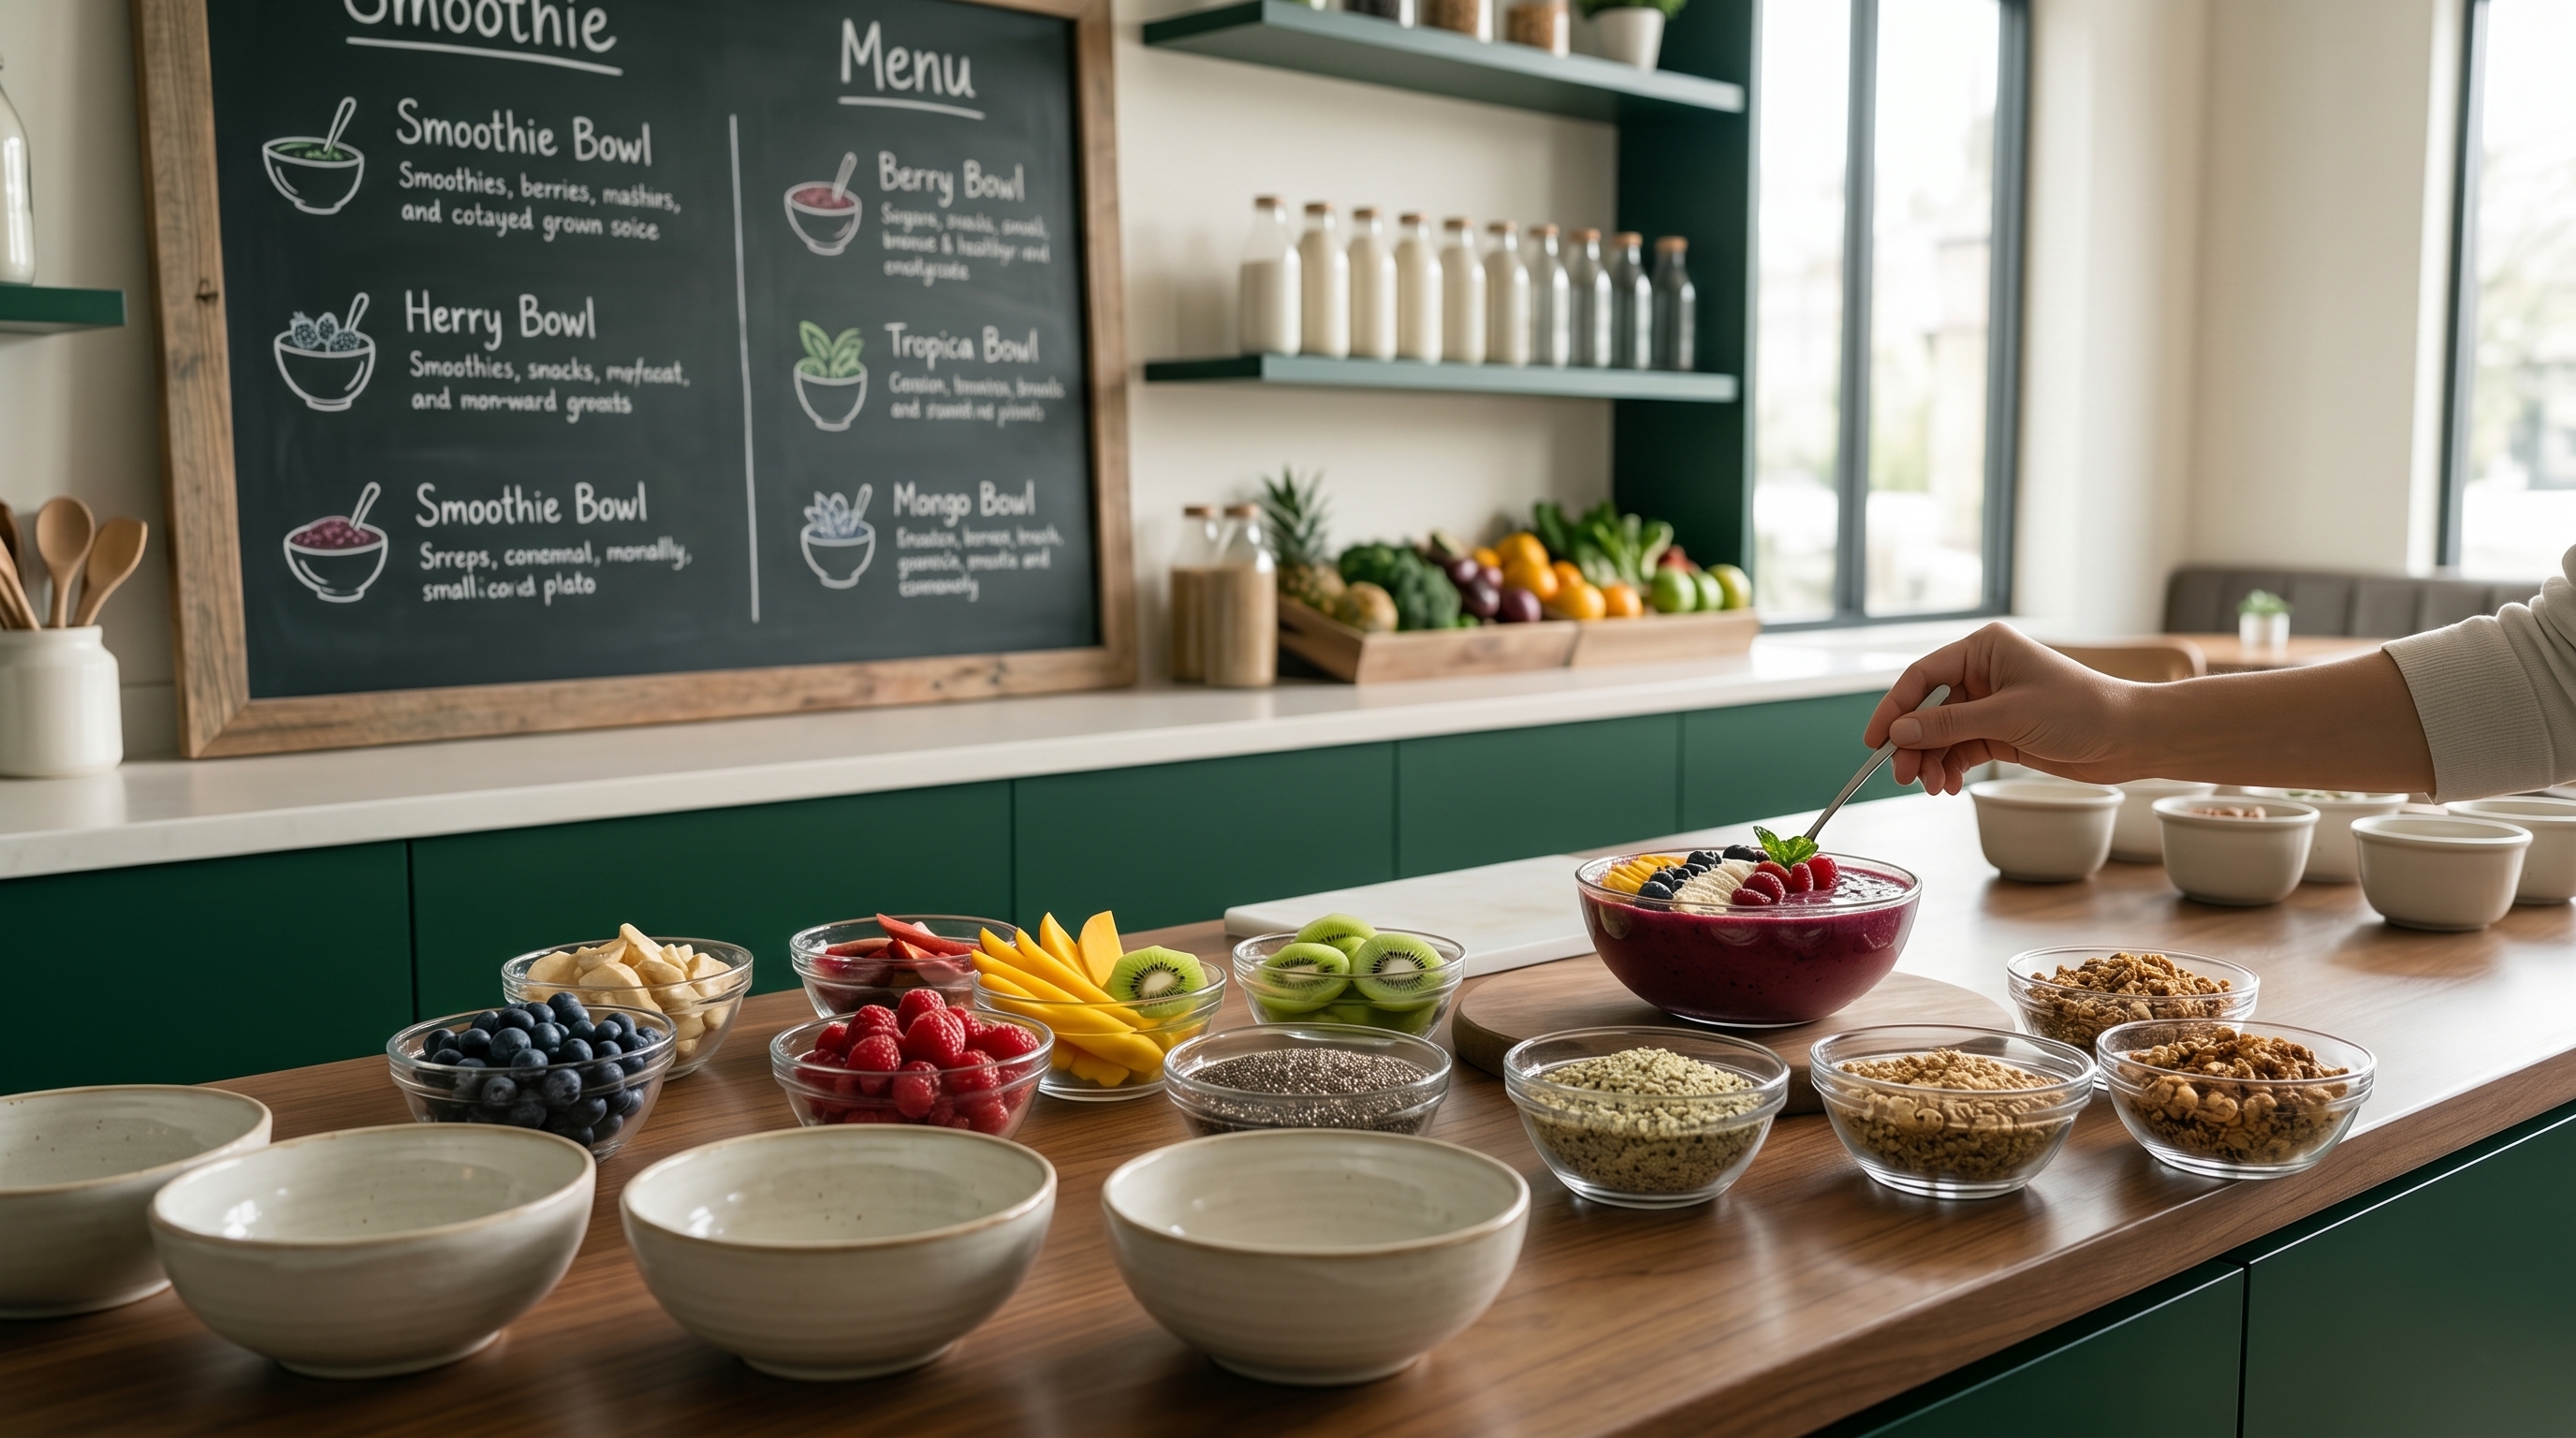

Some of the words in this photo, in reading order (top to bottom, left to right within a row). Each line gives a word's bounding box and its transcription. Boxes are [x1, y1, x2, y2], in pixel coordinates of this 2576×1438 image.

[840, 17, 977, 99] Menu
[395, 96, 559, 157] Smoothie
[572, 115, 652, 168] Bowl
[398, 160, 514, 200] Smoothies,
[520, 171, 597, 207] berries,
[877, 150, 954, 208] Berry
[962, 158, 1026, 203] Bowl
[401, 198, 444, 225] and
[542, 214, 604, 243] grown
[404, 288, 503, 352] Herry
[518, 292, 597, 340] Bowl
[409, 349, 521, 384] Smoothies,
[883, 320, 976, 372] Tropica
[982, 324, 1040, 364] Bowl
[410, 385, 453, 412] and
[415, 481, 563, 528] Smoothie
[574, 480, 648, 525] Bowl
[979, 477, 1036, 518] Bowl
[543, 570, 598, 608] plato
